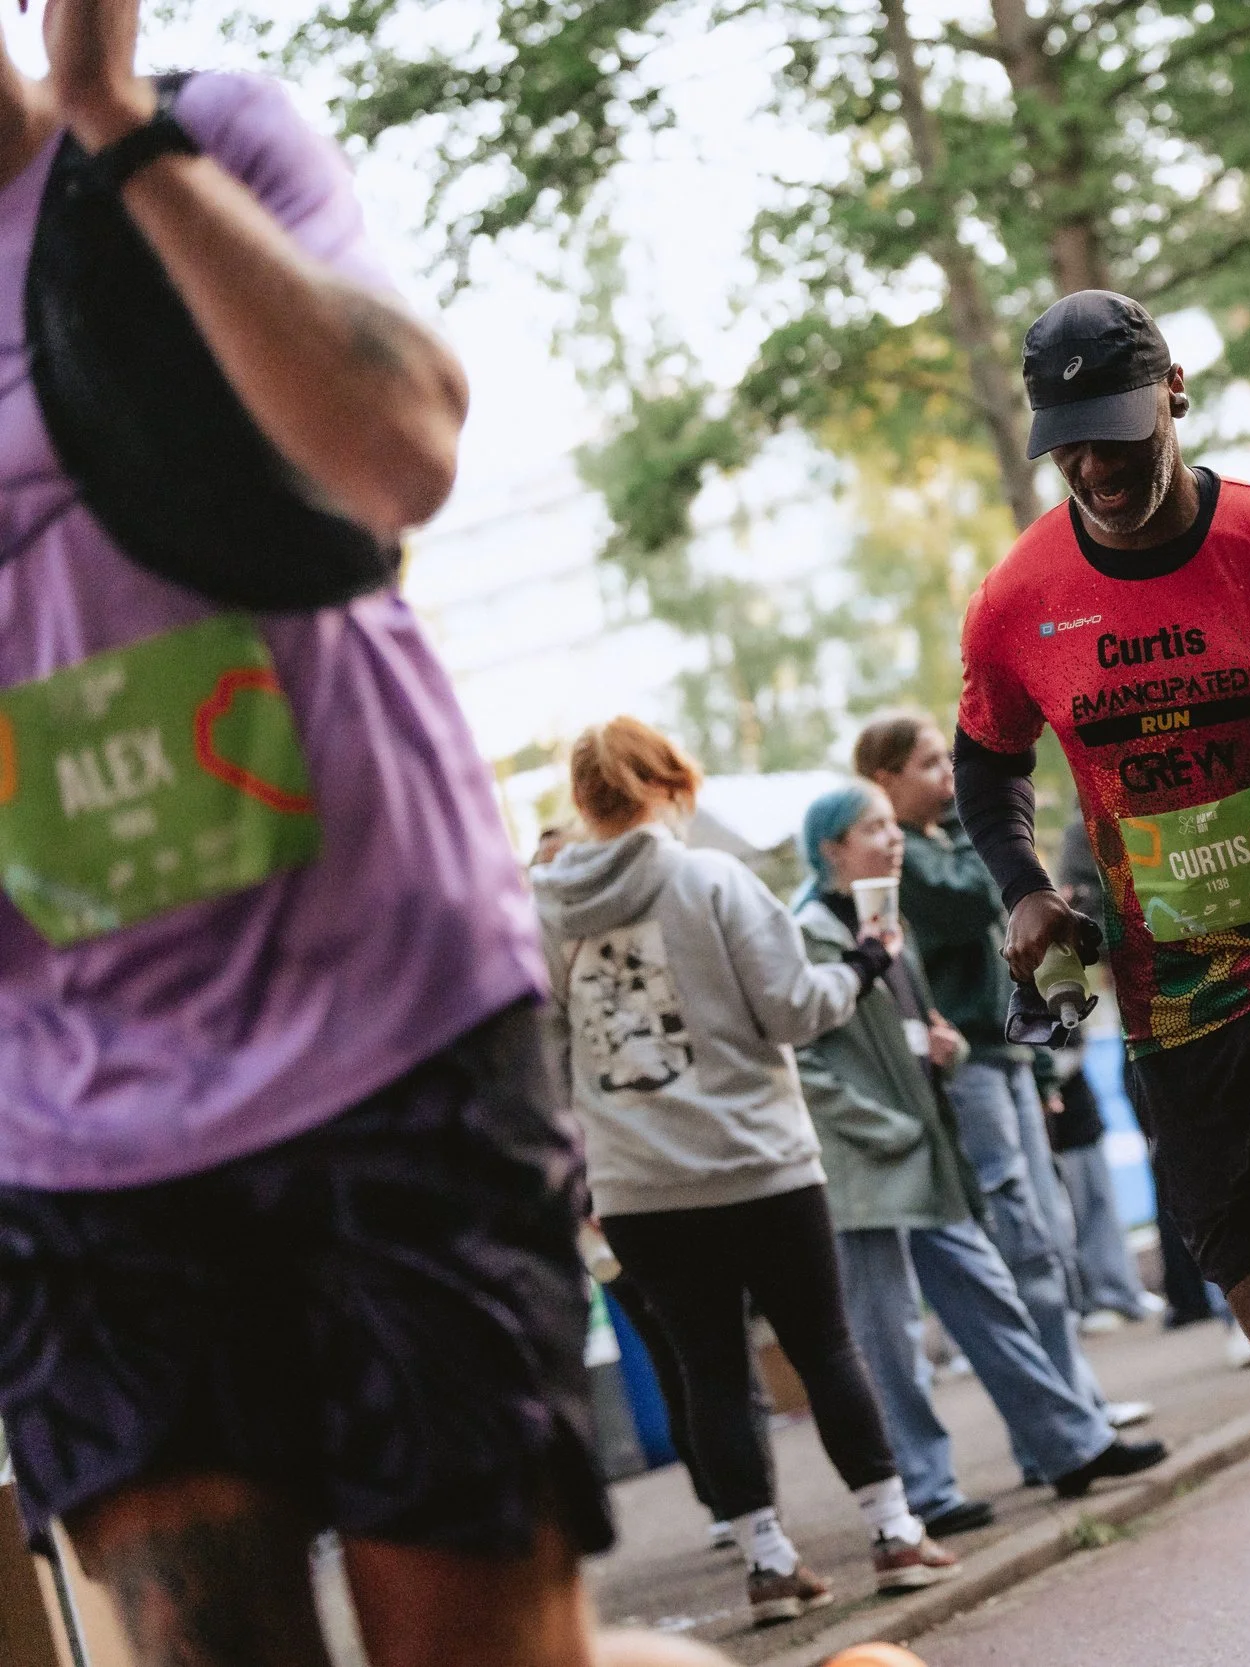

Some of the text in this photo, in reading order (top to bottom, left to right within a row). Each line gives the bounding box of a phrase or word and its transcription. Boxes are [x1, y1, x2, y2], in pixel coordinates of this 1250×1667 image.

[1097, 624, 1207, 669] Curtis
[1071, 667, 1250, 721] EMANCIPATED
[1141, 709, 1190, 734] RUN
[1119, 738, 1236, 794] CREW
[1205, 877, 1230, 893] 1138
